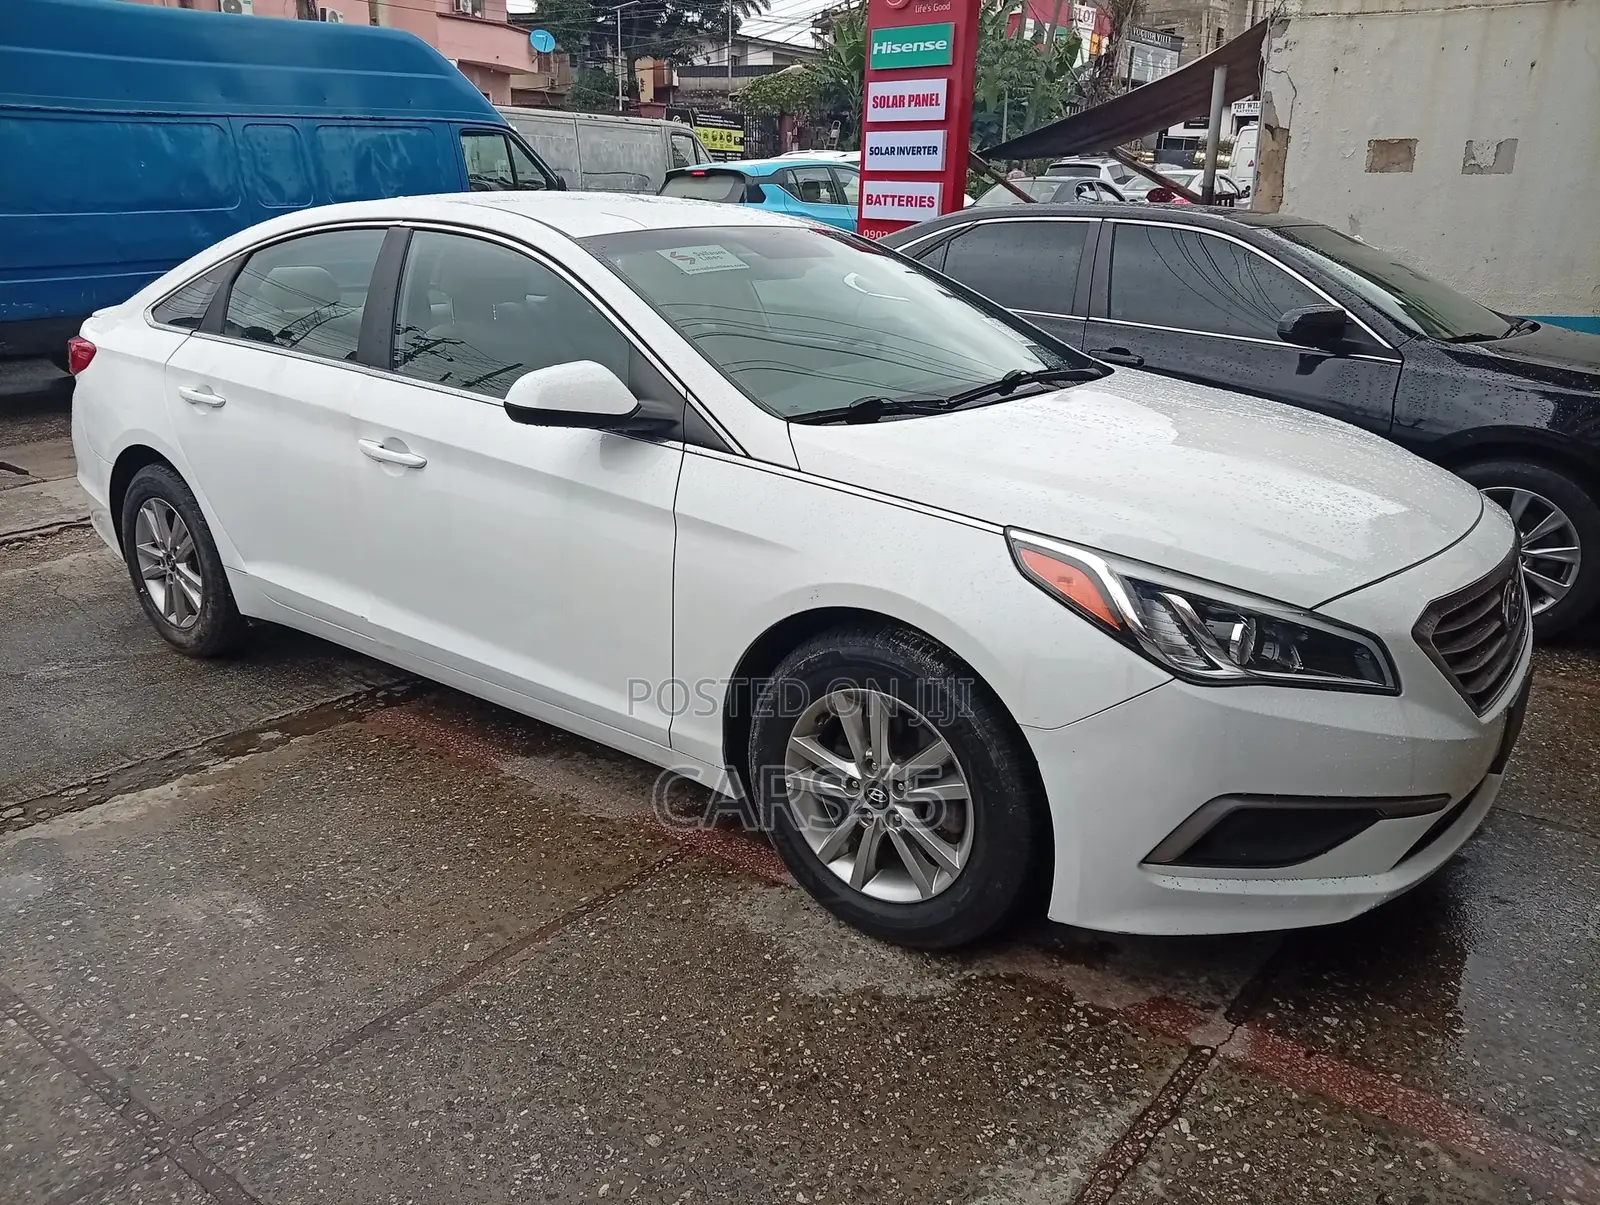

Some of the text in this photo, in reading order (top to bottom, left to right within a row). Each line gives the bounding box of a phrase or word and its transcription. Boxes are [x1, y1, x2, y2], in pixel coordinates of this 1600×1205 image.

[915, 2, 951, 13] Life's Good
[872, 40, 948, 55] Hisense
[872, 93, 941, 109] SOLAR PANEL
[869, 145, 938, 156] SOLAR INVERTER
[866, 193, 935, 208] BATTERIES
